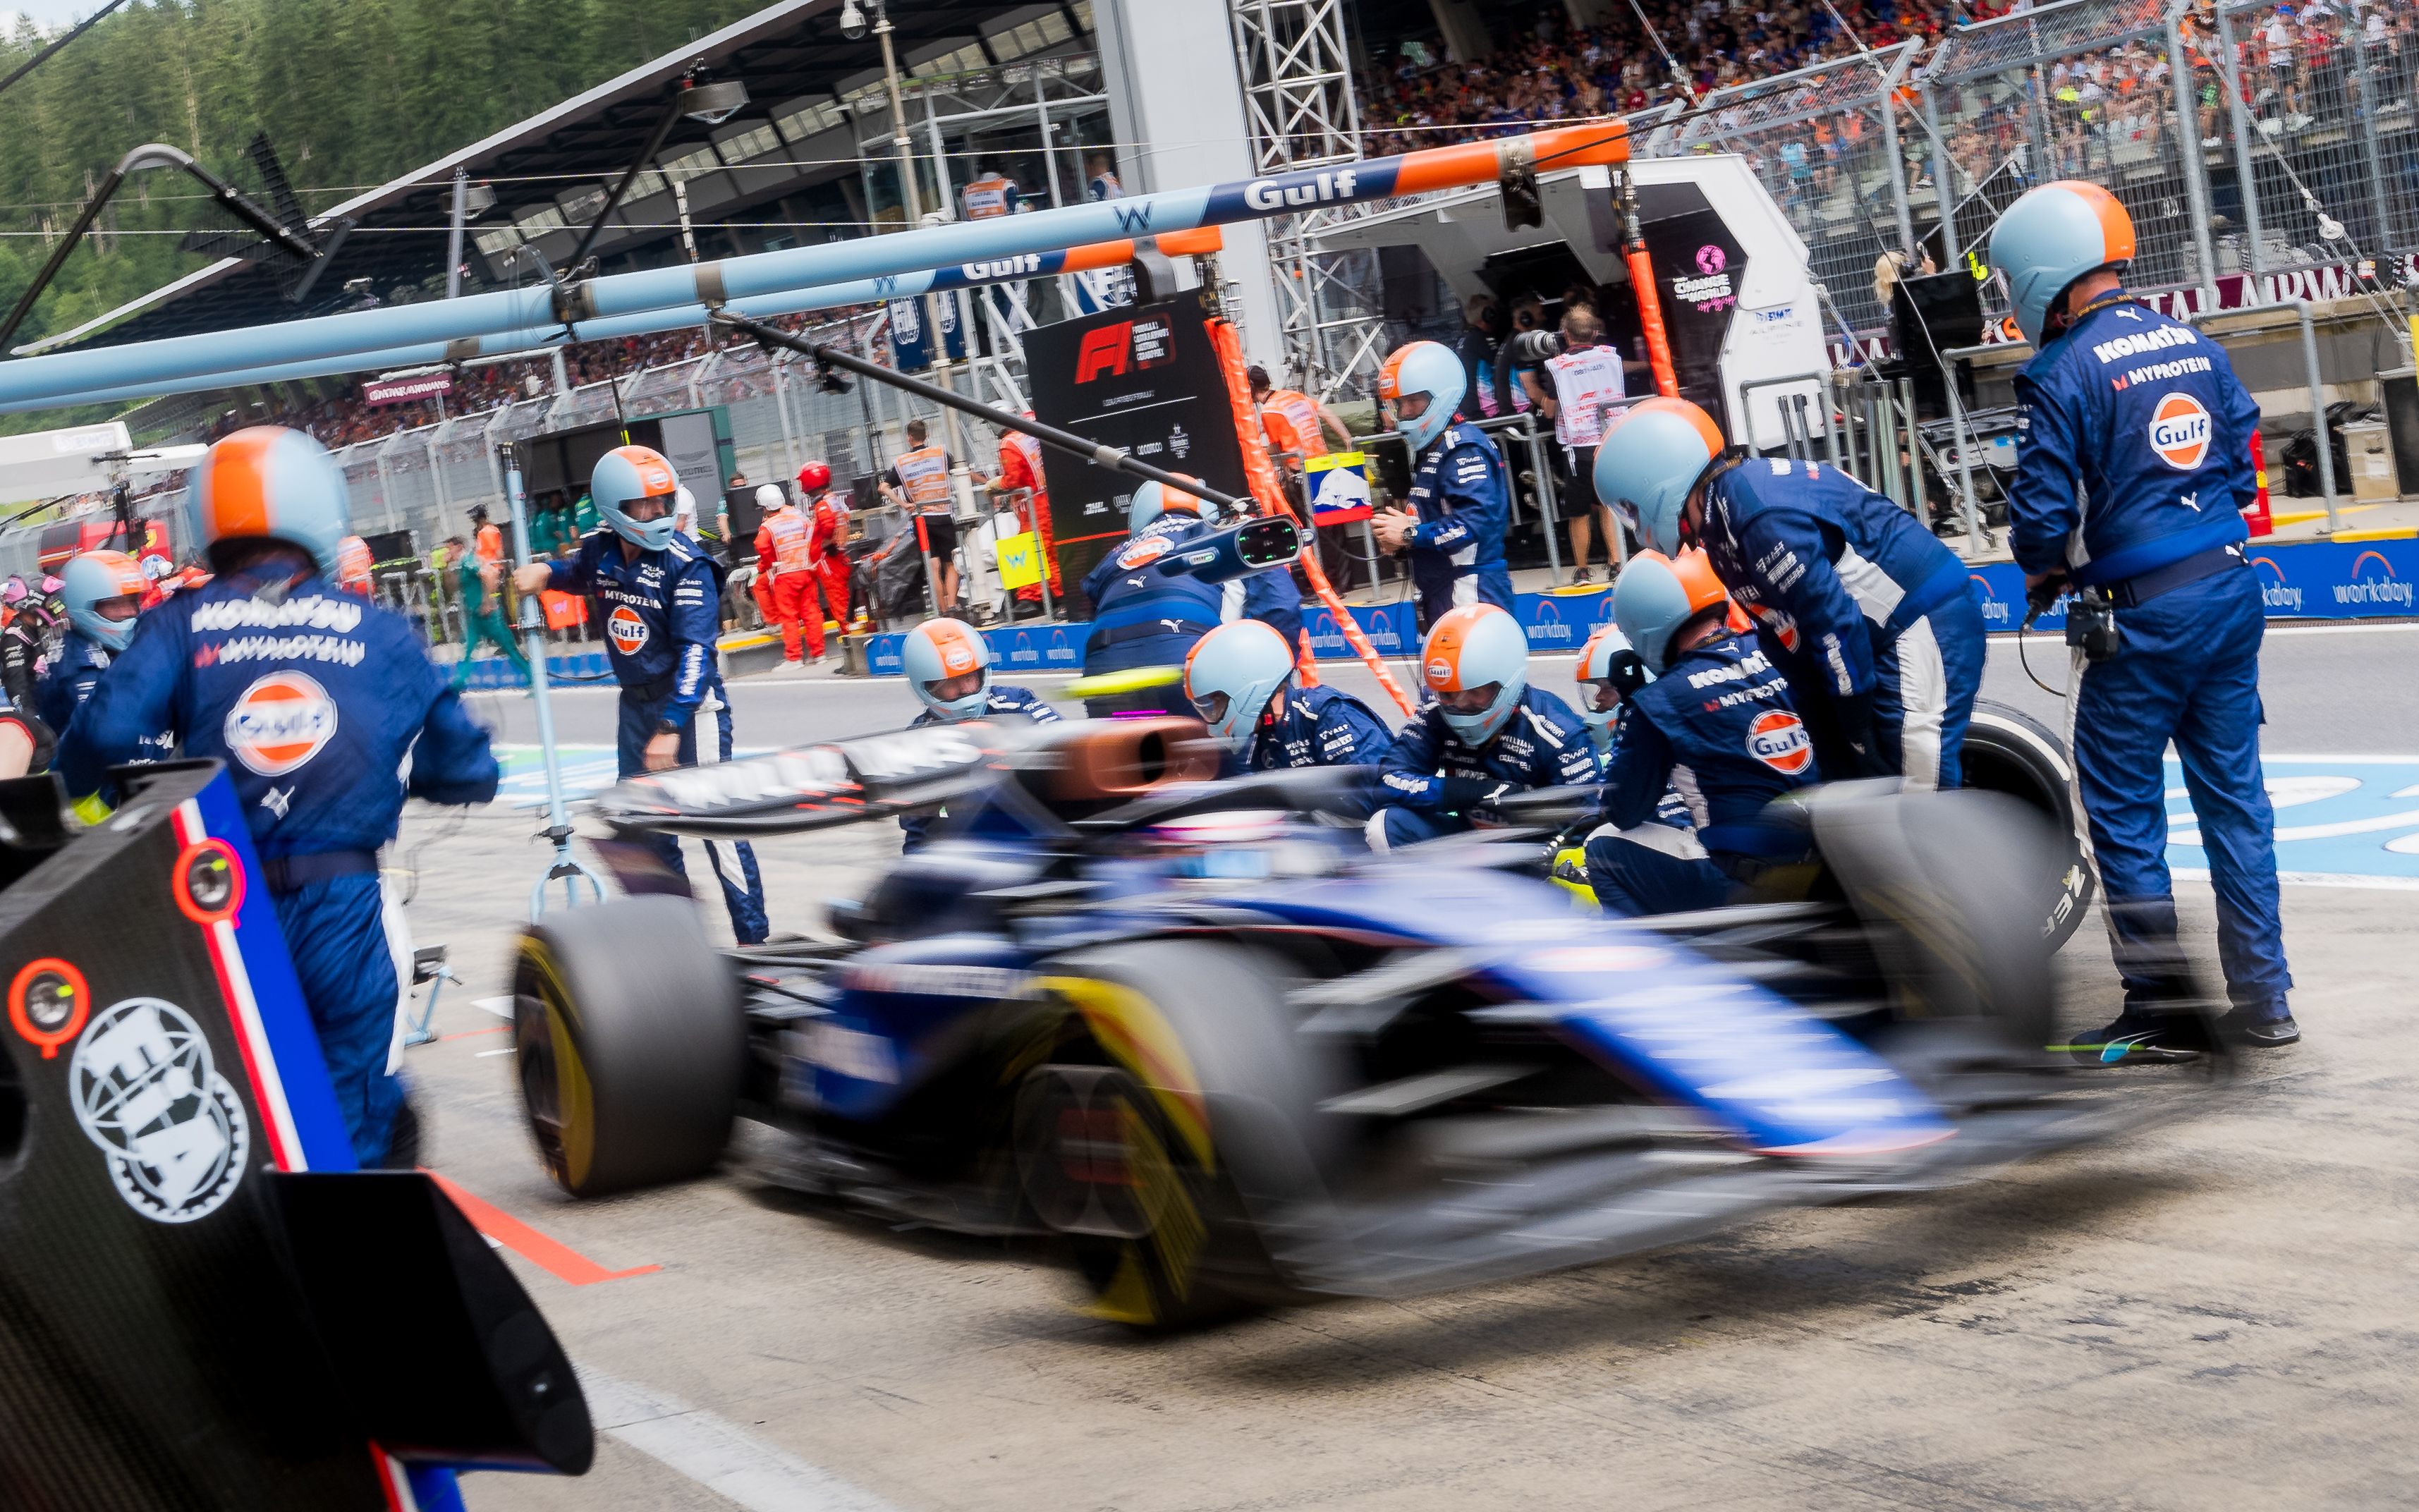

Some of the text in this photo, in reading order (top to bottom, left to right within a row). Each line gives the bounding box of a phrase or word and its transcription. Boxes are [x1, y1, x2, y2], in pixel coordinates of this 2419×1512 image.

[1243, 169, 1358, 211] Gulf
[961, 252, 1041, 281] Gulf
[1674, 274, 1730, 294] CHANGE
[2092, 323, 2198, 365] KOMATSU
[2127, 356, 2212, 386] MYPROTEIN
[2155, 418, 2206, 446] Gulf
[2332, 575, 2413, 609] workday
[190, 594, 362, 633] KOMATSU
[611, 621, 645, 638] Gulf
